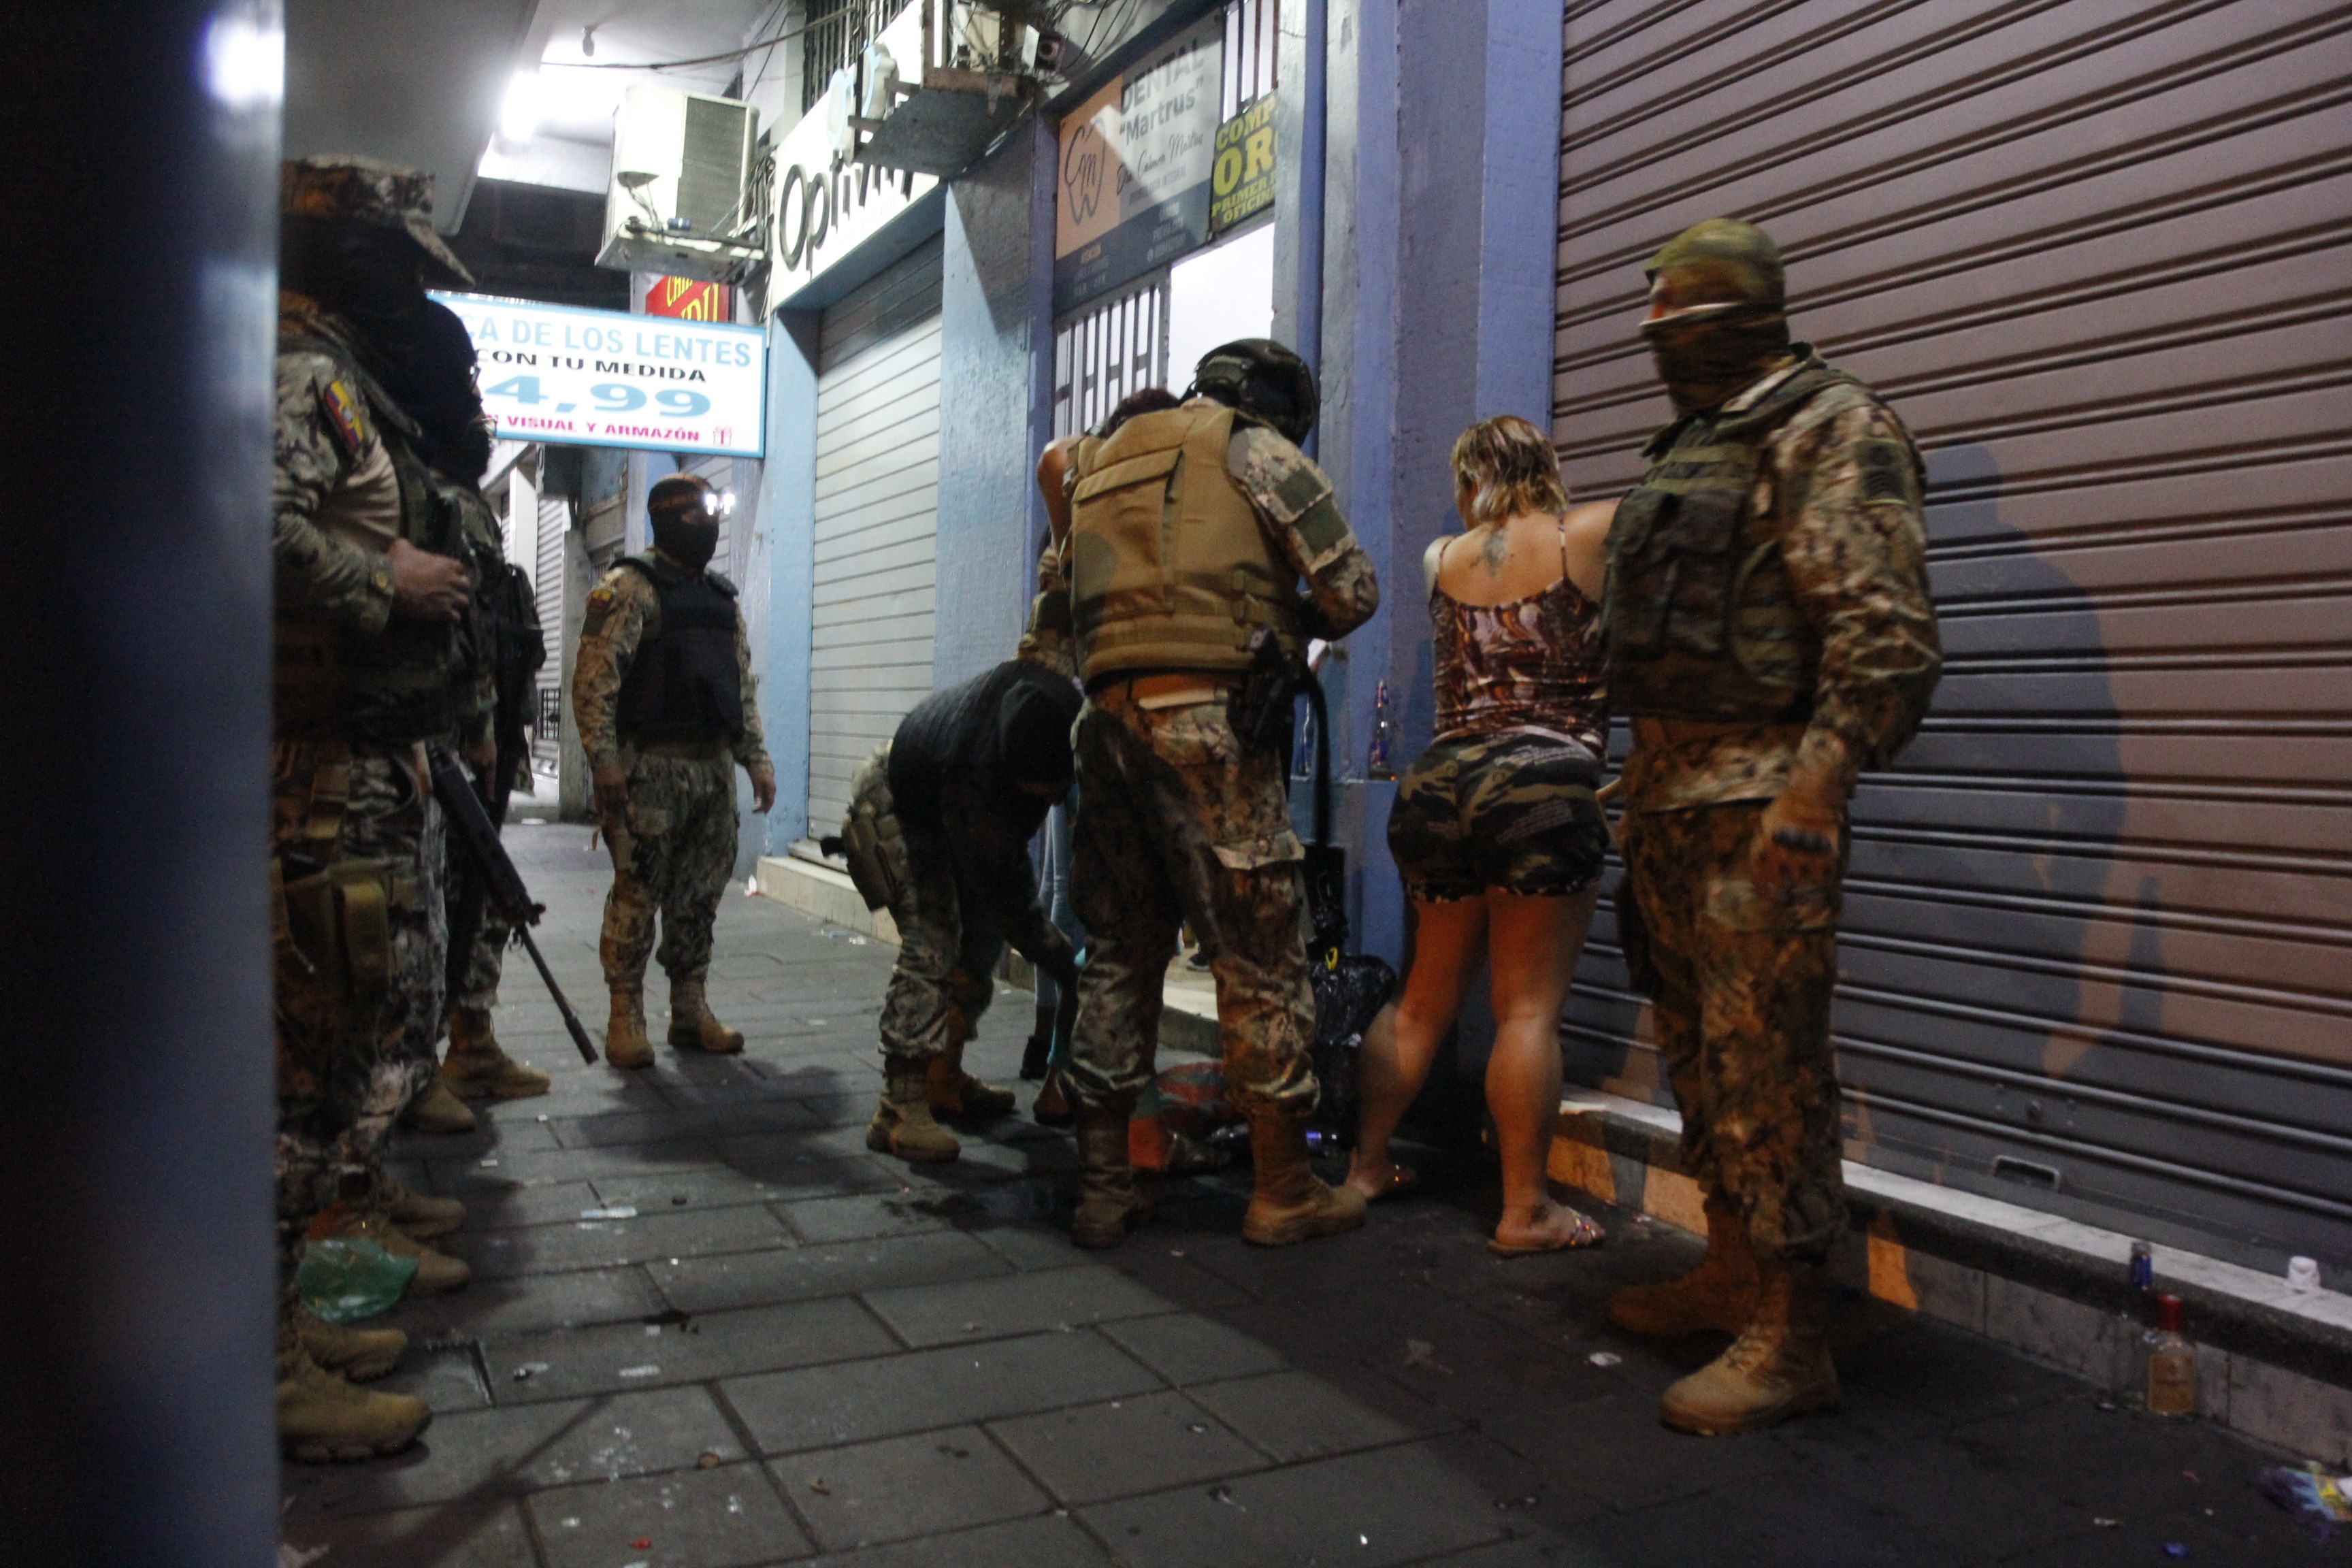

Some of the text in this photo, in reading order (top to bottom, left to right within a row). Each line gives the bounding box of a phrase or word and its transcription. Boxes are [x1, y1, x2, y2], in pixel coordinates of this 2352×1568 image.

[1120, 38, 1204, 116] DENTAL
[1216, 95, 1277, 151] COMP
[1213, 127, 1279, 195] OR
[476, 348, 706, 382] CON TU MEDIDA
[512, 319, 552, 346] DE
[565, 325, 624, 354] LOS
[636, 332, 751, 367] LENTES
[507, 415, 577, 433] VISUAL
[587, 422, 600, 433] Y
[604, 423, 700, 442] ARMAZÓN
